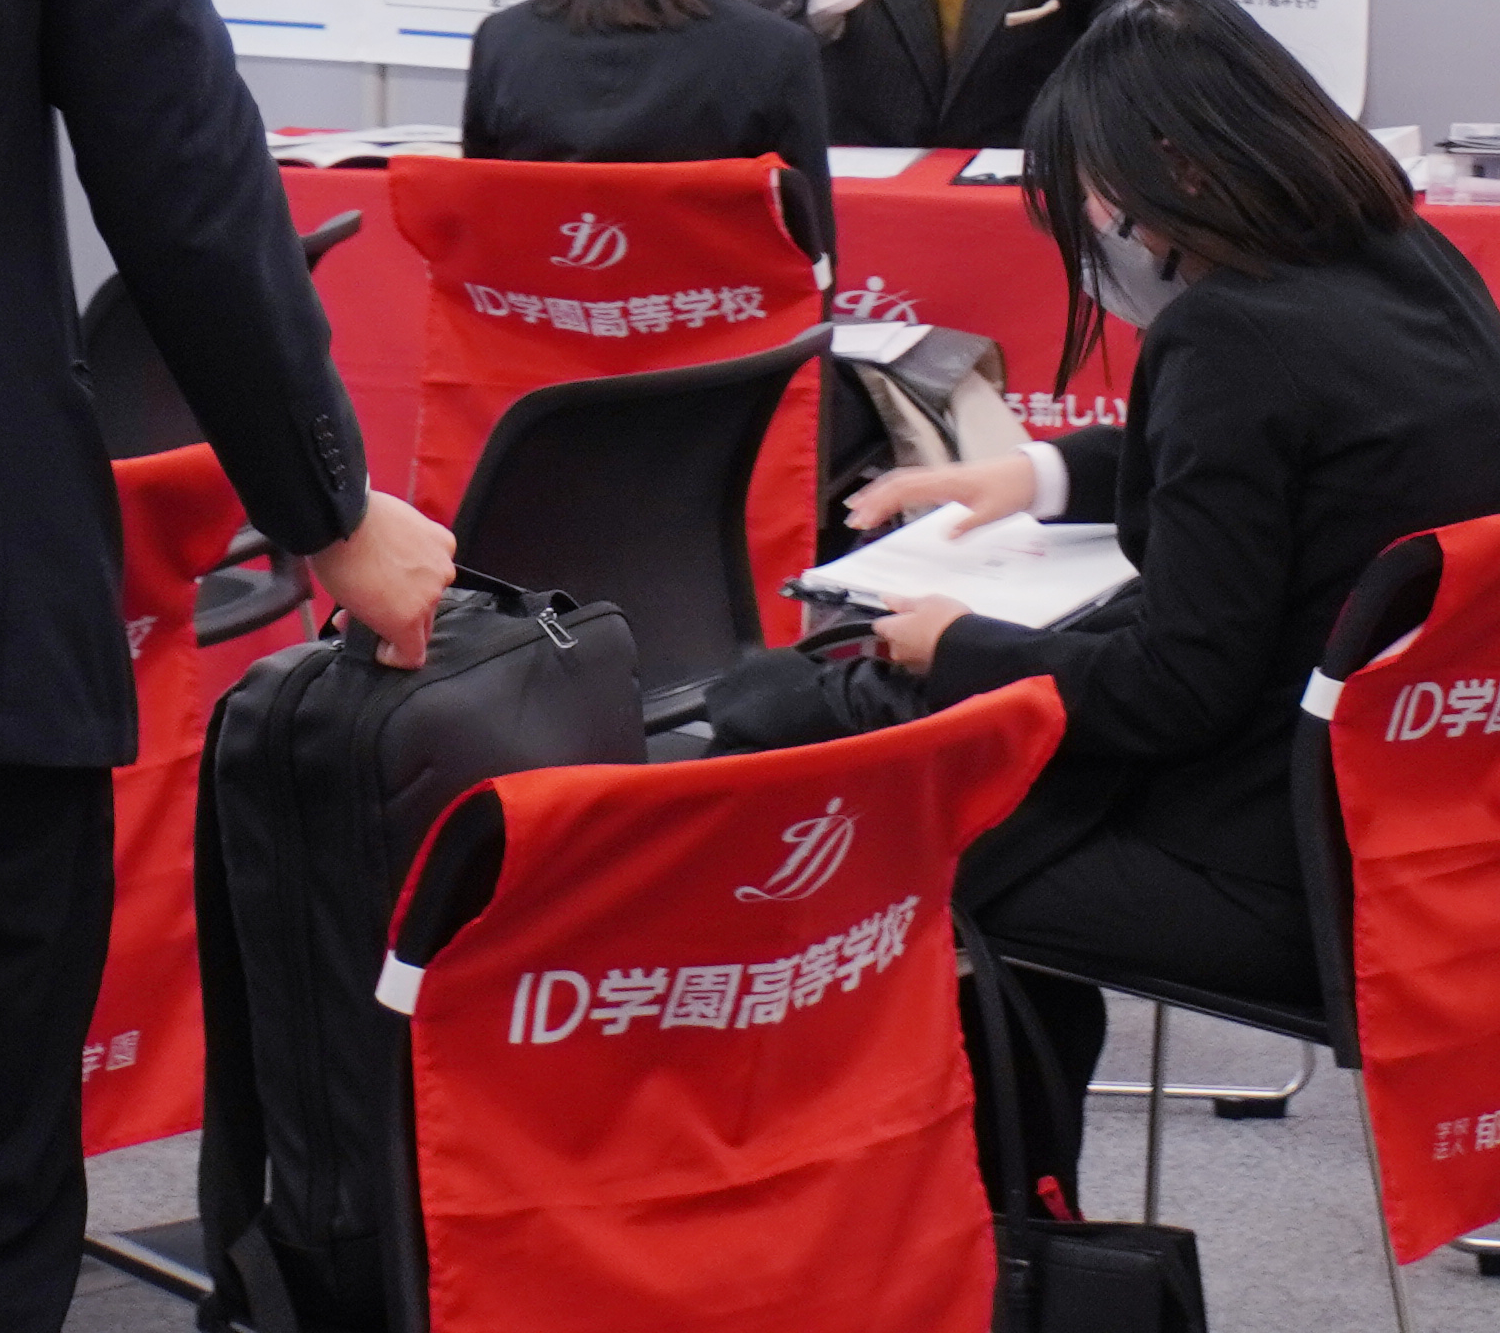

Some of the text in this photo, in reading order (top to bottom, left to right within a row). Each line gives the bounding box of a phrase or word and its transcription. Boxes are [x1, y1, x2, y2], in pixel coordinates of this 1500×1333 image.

[463, 282, 767, 339] ID学園高等学校
[508, 895, 922, 1047] ID学園高等学校
